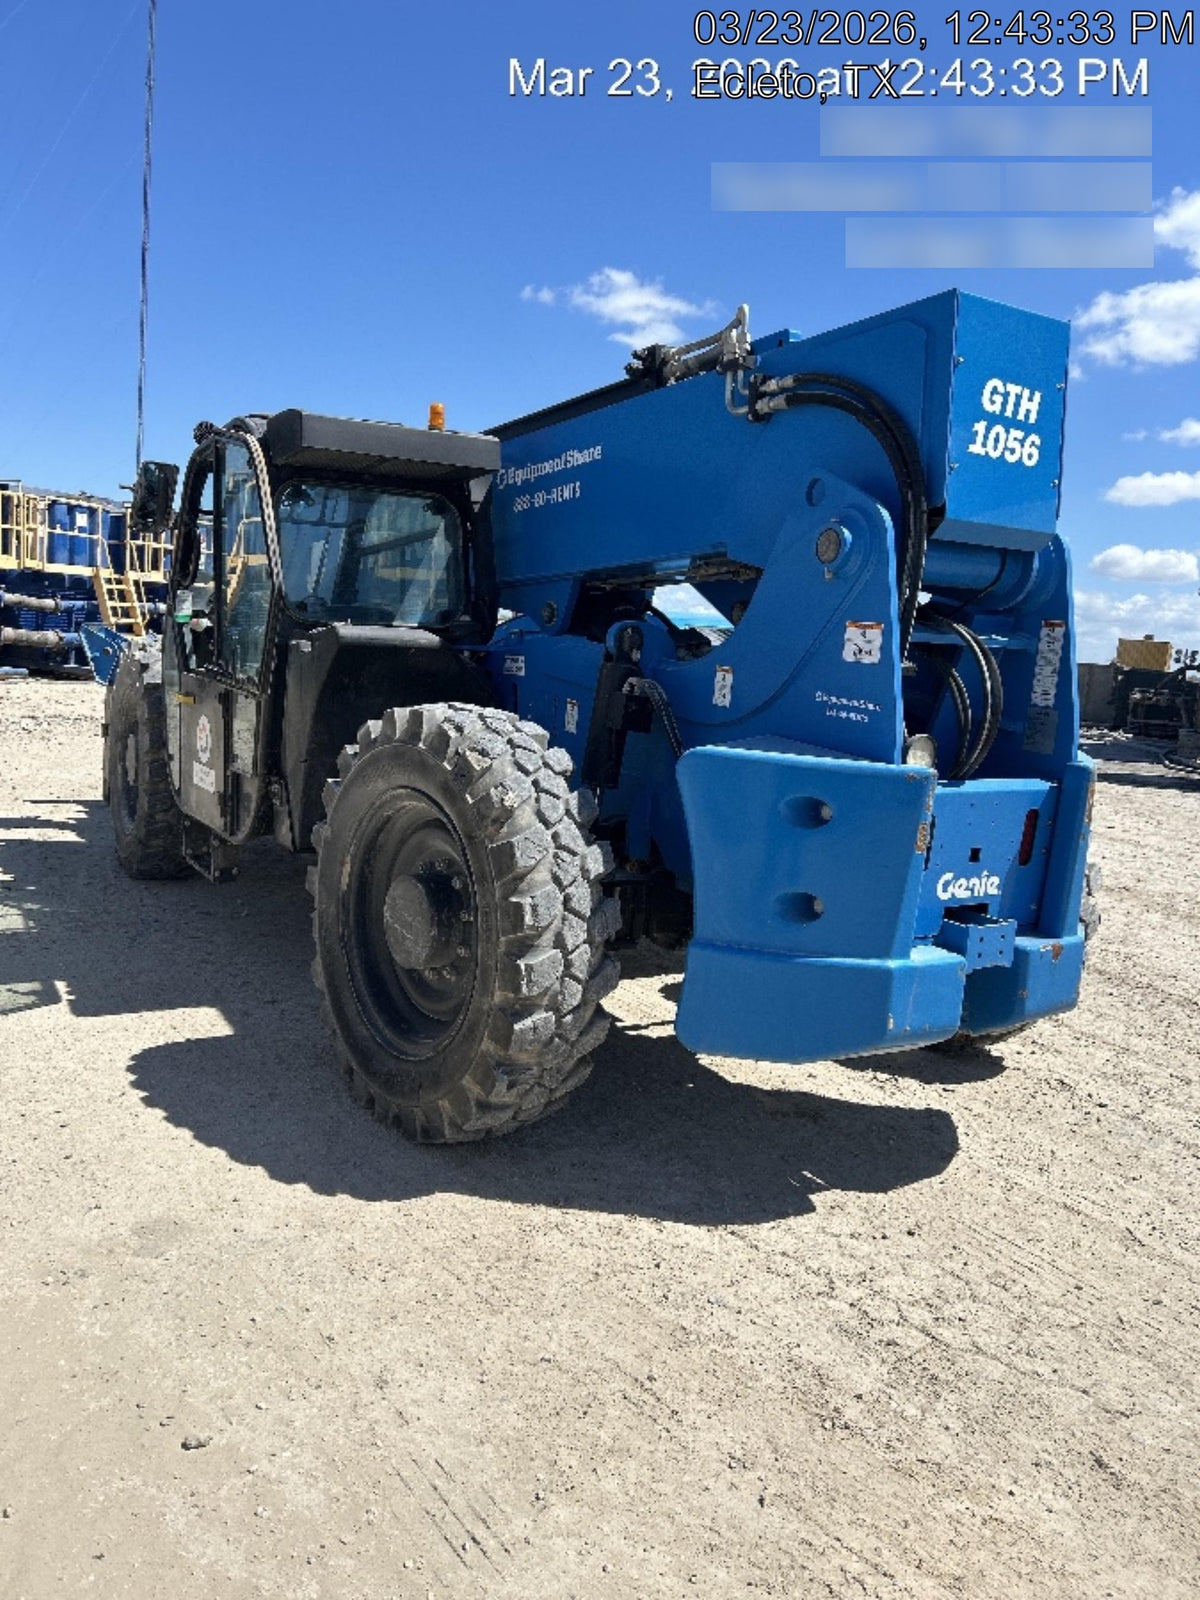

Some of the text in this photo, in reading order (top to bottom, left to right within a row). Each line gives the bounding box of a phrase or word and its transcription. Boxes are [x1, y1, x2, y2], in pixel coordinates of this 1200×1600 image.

[981, 378, 1042, 424] GTH
[967, 419, 1041, 467] 1056
[936, 870, 1001, 900] Genie
